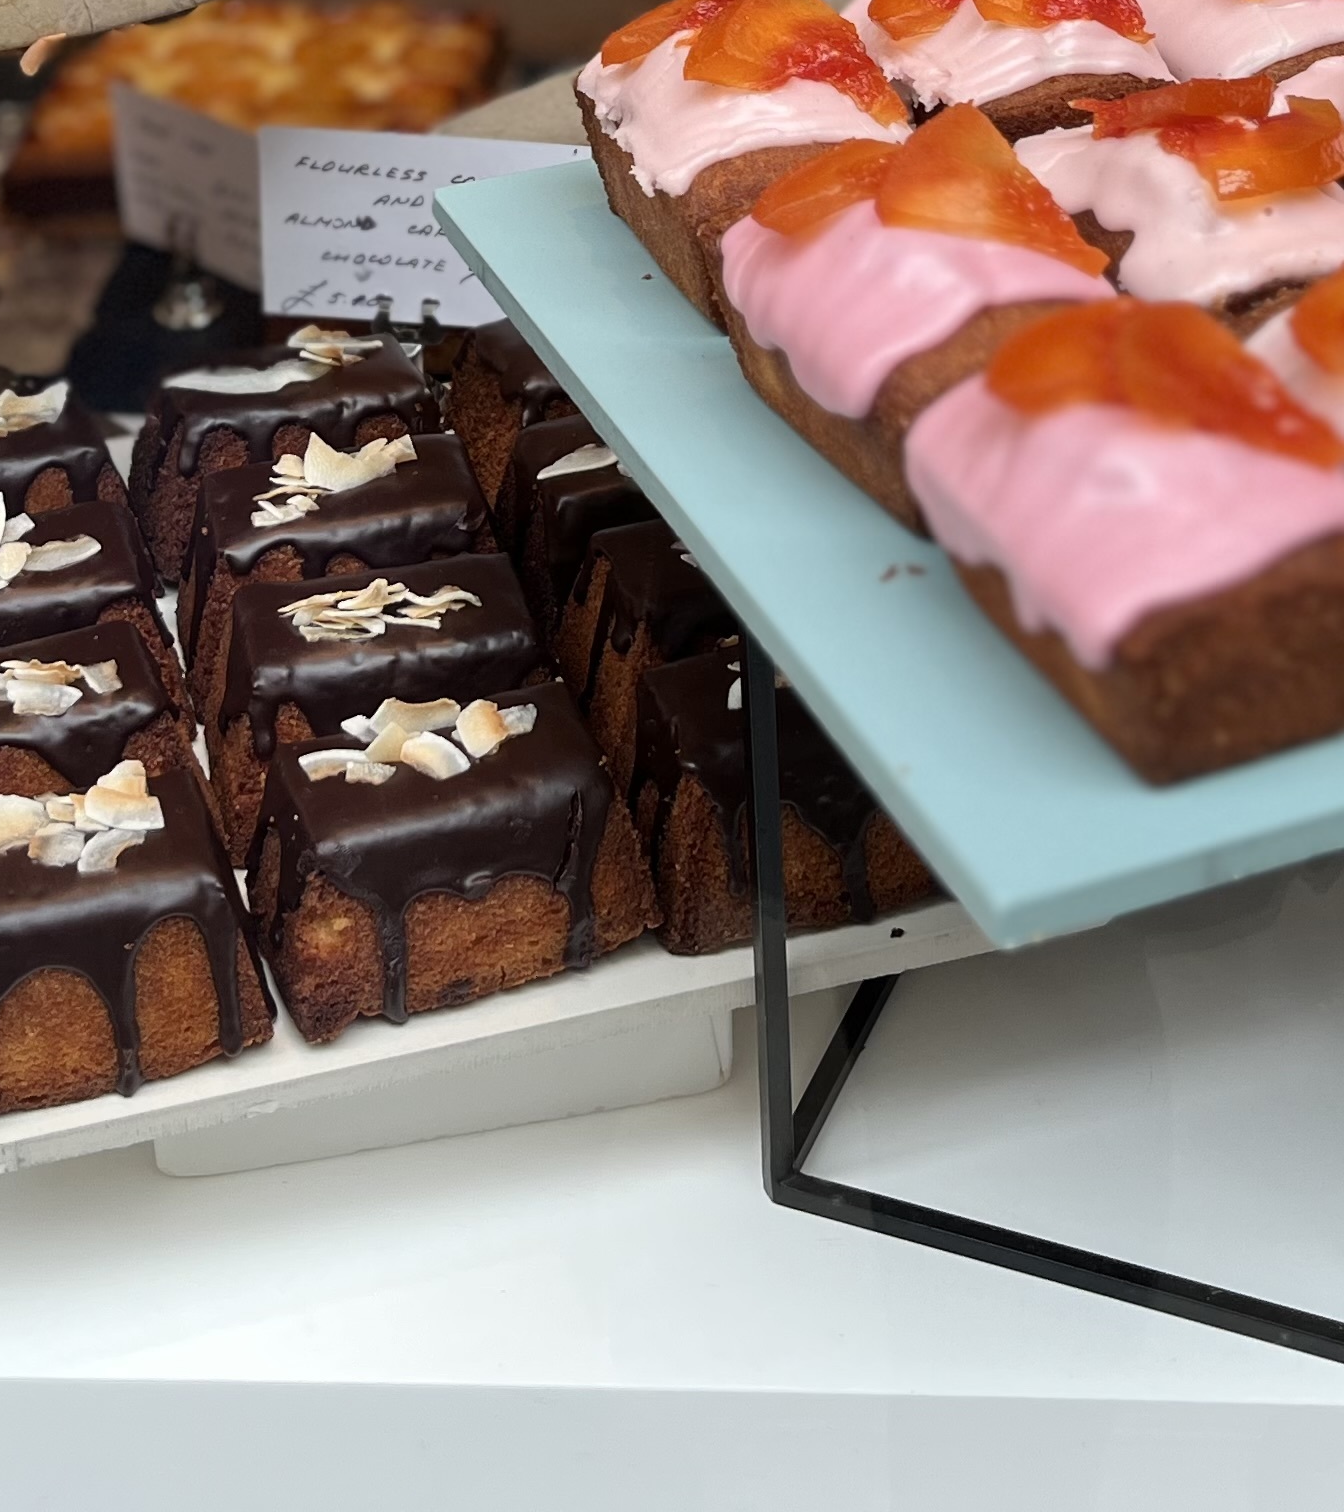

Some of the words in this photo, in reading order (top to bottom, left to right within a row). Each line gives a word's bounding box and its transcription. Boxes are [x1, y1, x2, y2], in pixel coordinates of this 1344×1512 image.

[294, 155, 429, 183] FLOURLESS
[372, 194, 425, 208] AND
[320, 250, 448, 273] CHOCOLATE
